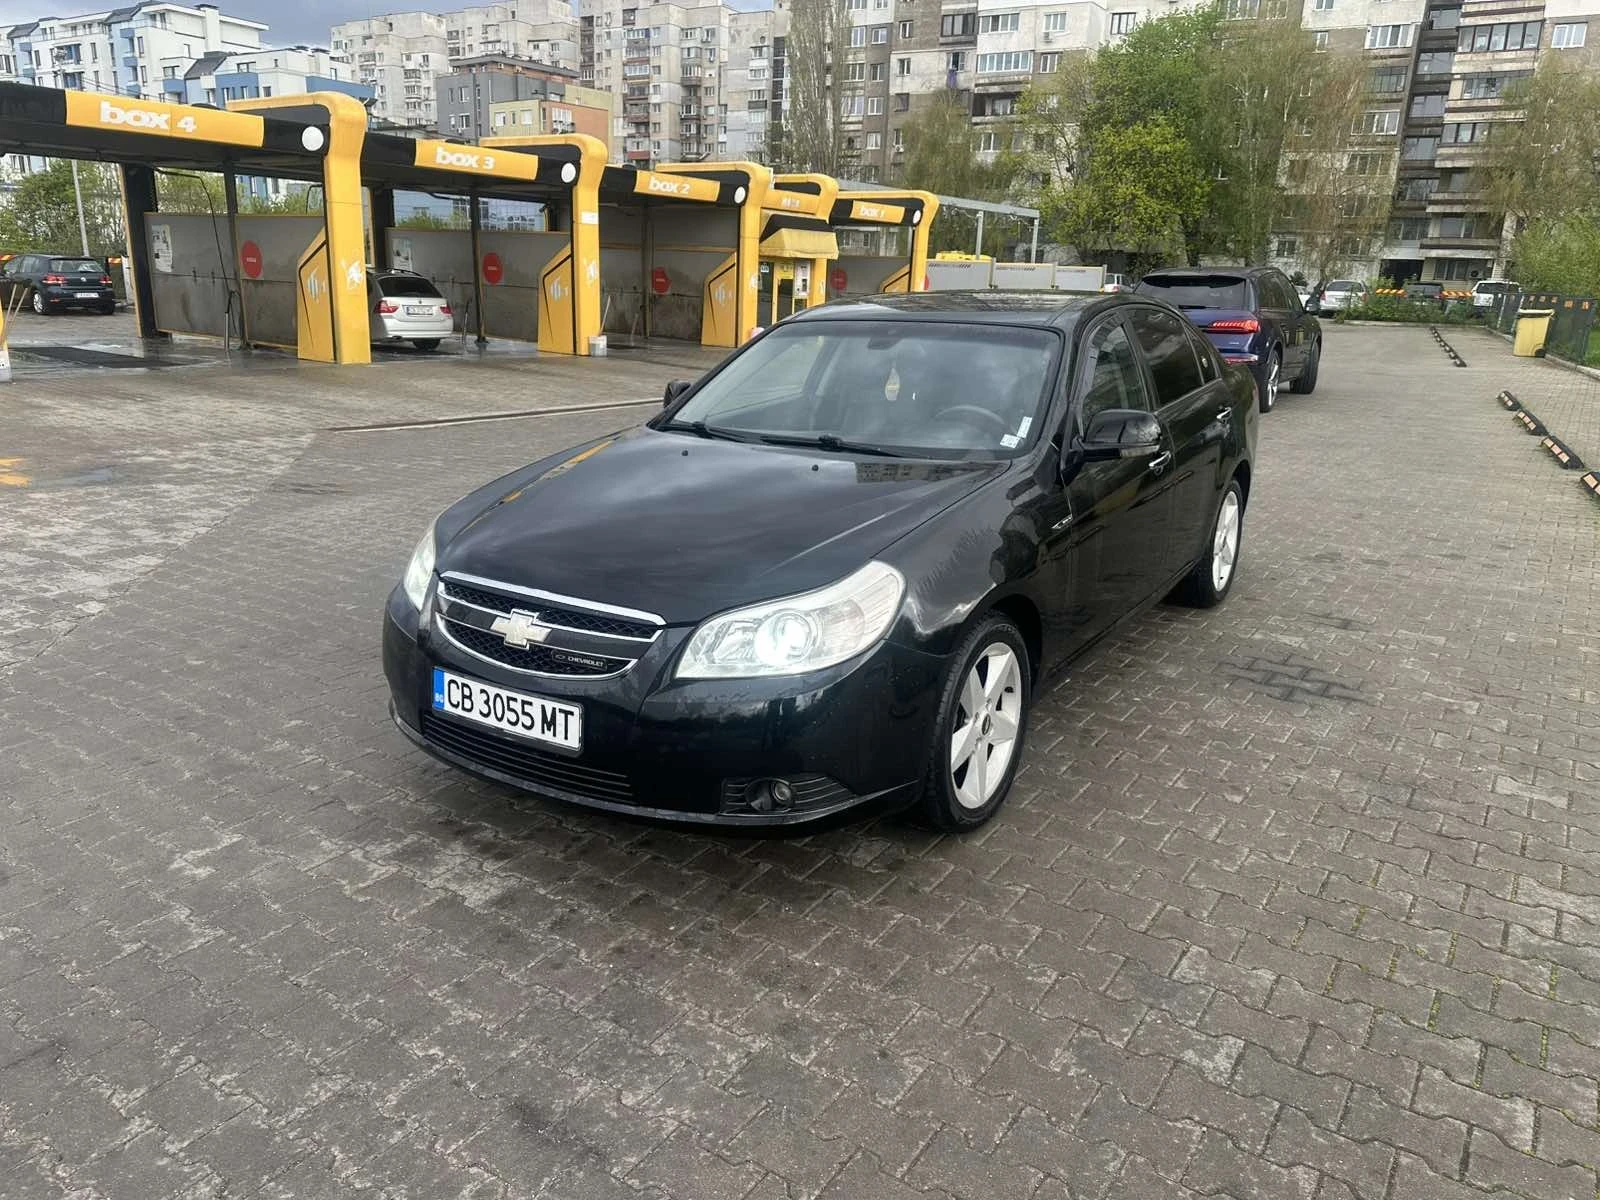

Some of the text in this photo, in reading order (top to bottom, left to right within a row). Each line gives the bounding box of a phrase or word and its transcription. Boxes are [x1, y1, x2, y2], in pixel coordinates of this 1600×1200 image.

[100, 101, 197, 133] box 4
[436, 146, 496, 170] box 3
[649, 176, 690, 195] box 2
[860, 205, 880, 218] box
[567, 656, 604, 667] CHEVROLET
[447, 679, 575, 740] CB 3055 MT
